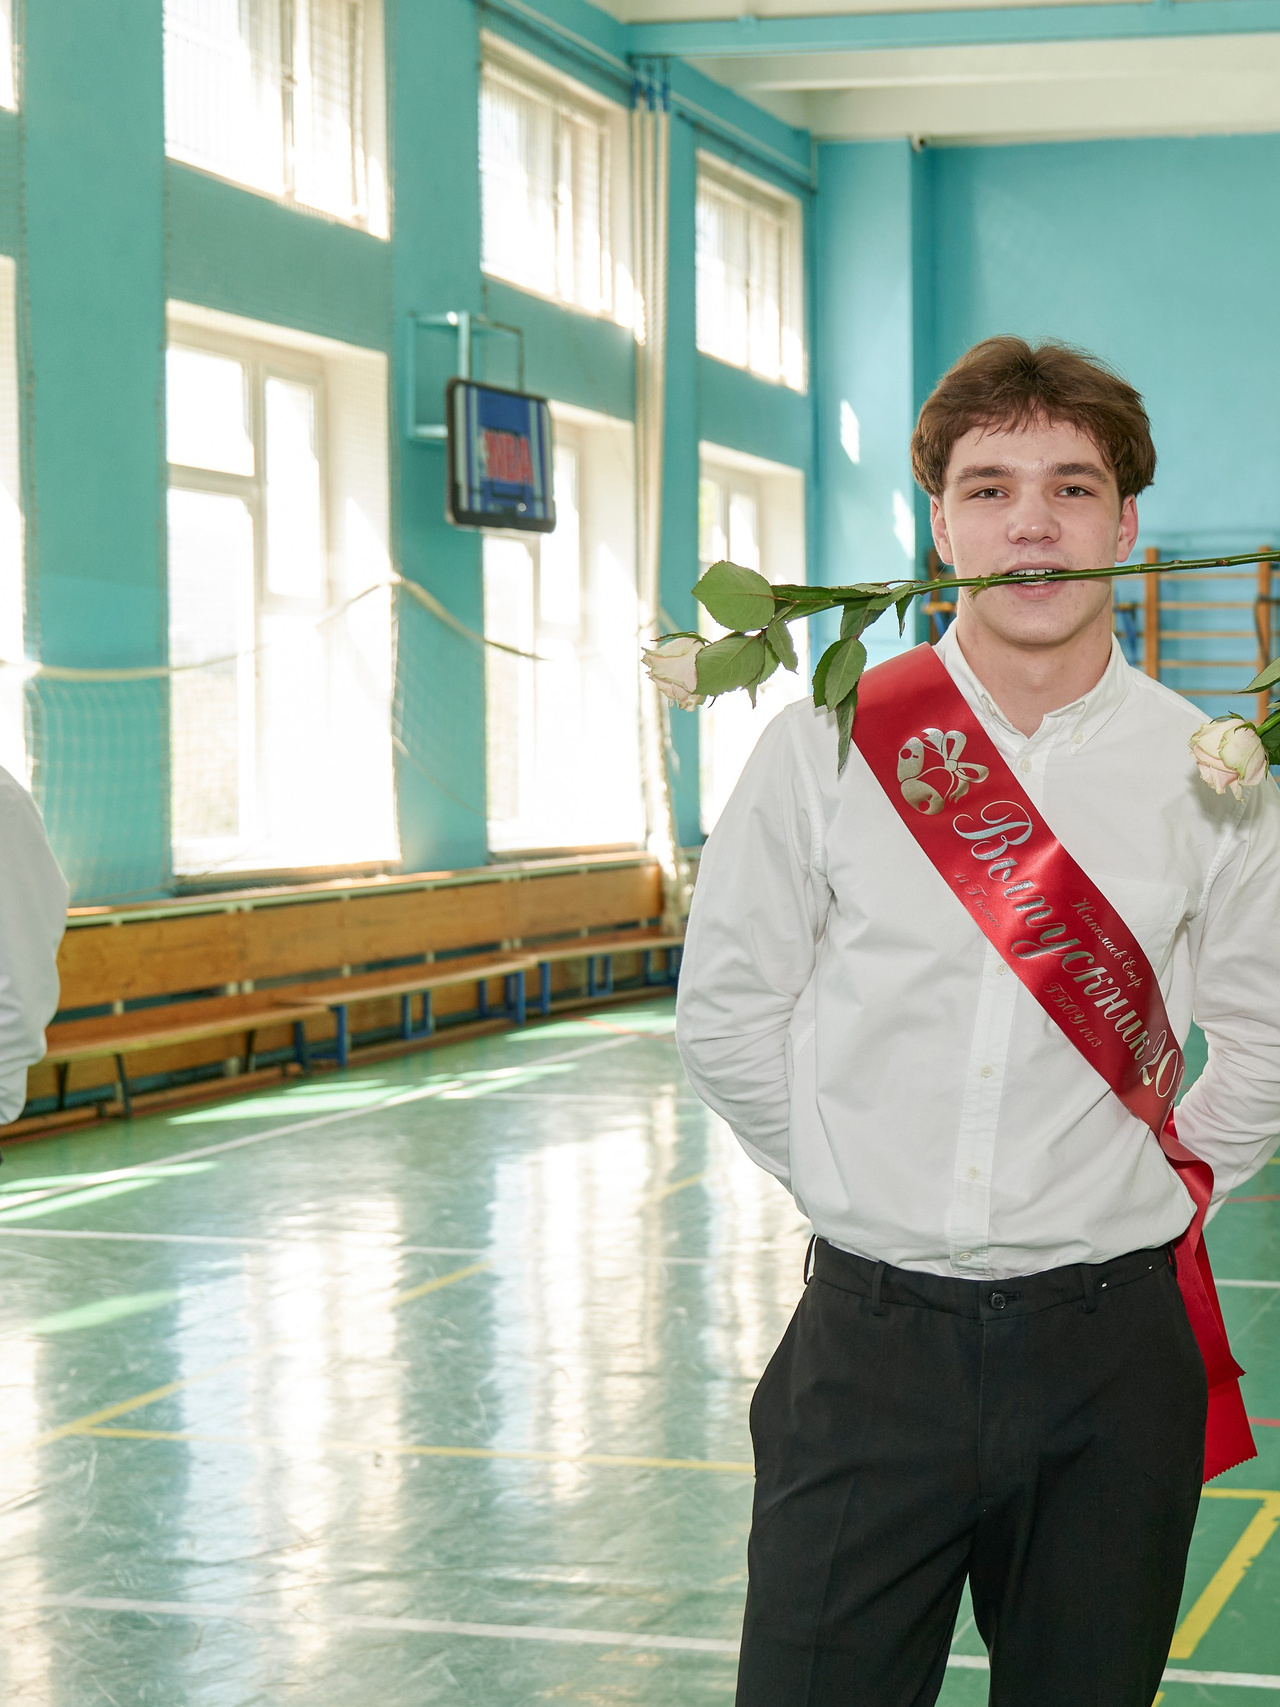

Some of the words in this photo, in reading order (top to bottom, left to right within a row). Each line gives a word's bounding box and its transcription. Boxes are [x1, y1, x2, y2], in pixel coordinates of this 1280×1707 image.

[482, 428, 535, 487] NBA
[954, 872, 970, 884] 11
[965, 883, 988, 898] Г
[953, 800, 1150, 1061] Выпускник
[1070, 897, 1127, 960] Николаев
[1122, 956, 1144, 989] Егор
[1043, 982, 1088, 1025] ГБОУ
[1078, 1022, 1103, 1048] 1413
